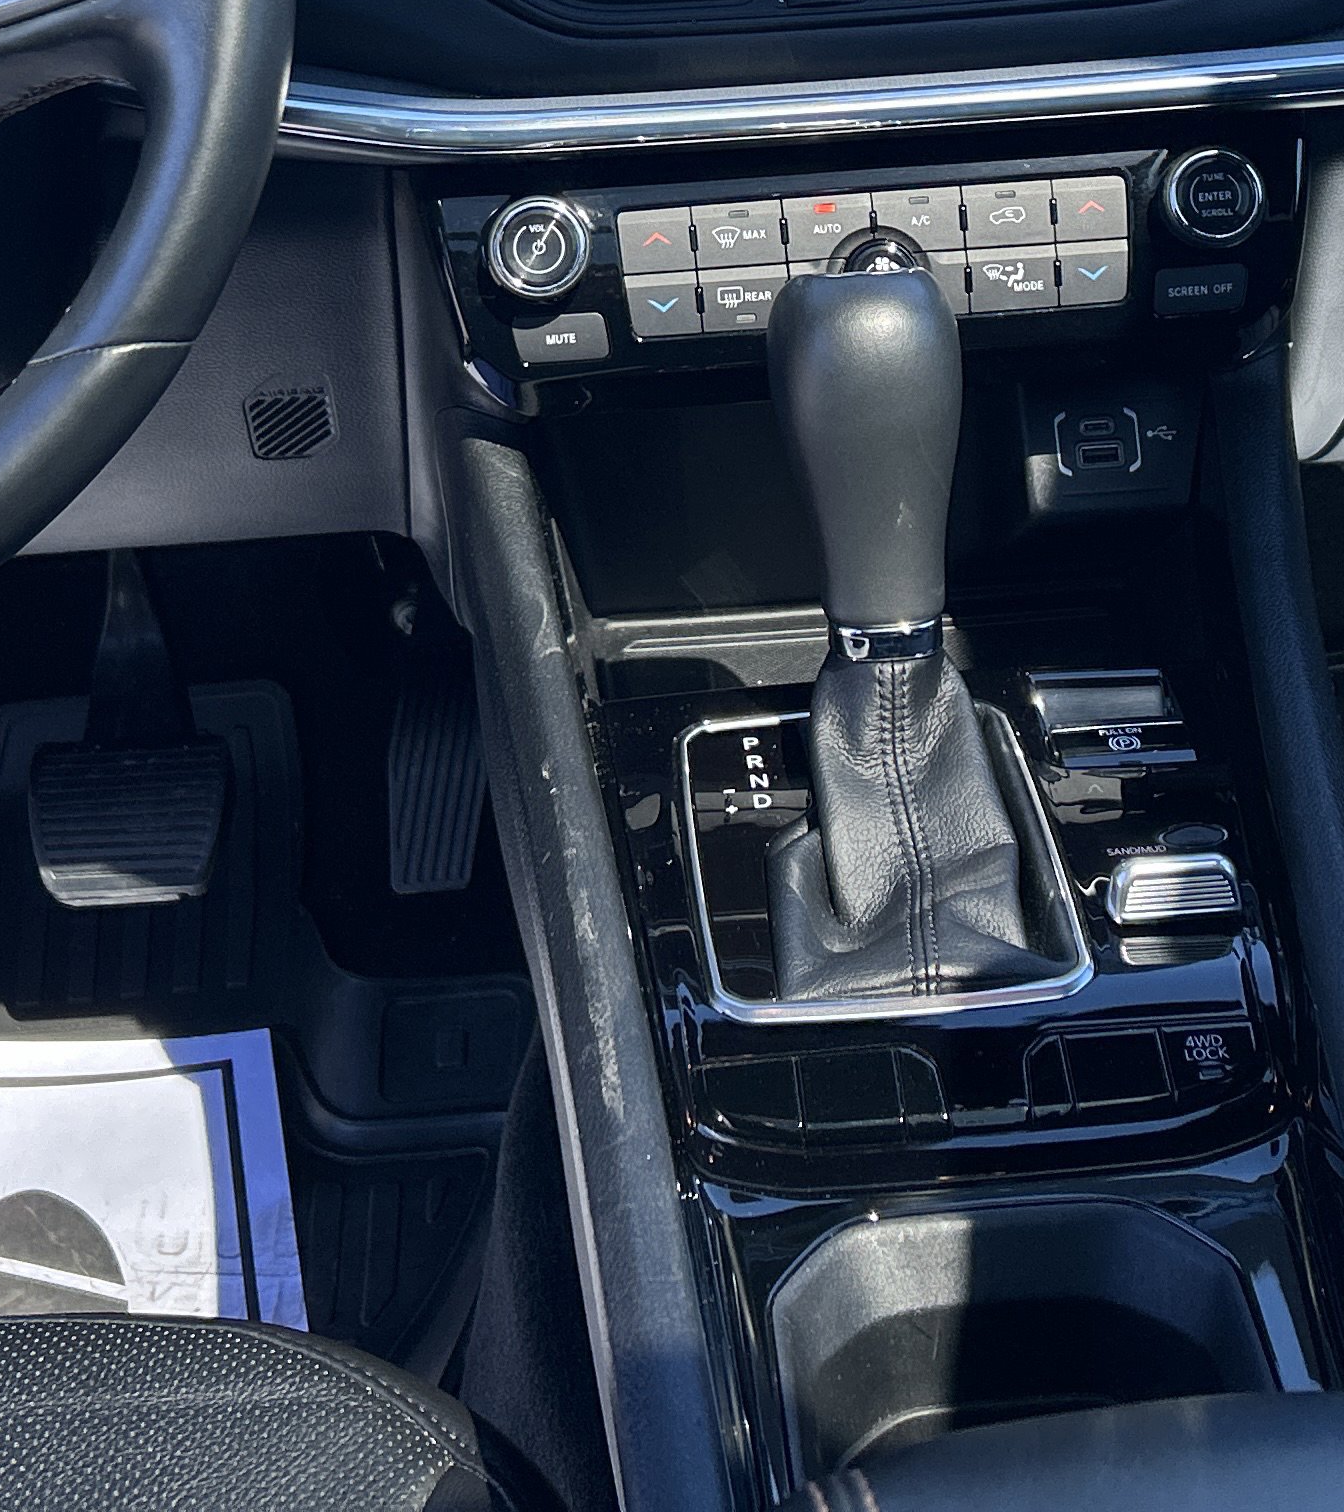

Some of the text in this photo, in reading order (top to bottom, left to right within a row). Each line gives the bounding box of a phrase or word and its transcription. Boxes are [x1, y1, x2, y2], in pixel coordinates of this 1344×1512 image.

[1202, 172, 1226, 182] TUNE
[1198, 190, 1233, 203] ENTER
[1200, 206, 1234, 218] SCROLL
[911, 214, 931, 227] A/C
[528, 224, 546, 234] VOL
[743, 228, 767, 241] MAX
[813, 223, 842, 235] AUTO
[1013, 279, 1045, 292] MODE
[1168, 282, 1234, 297] SCREEN OFF
[744, 290, 773, 303] REAR
[545, 332, 577, 345] MUTE
[742, 736, 759, 751] P
[746, 754, 764, 769] R
[749, 773, 769, 789] N
[752, 793, 772, 809] D
[1106, 844, 1167, 857] SAND/MUD
[1185, 1034, 1223, 1048] 4WD
[1183, 1046, 1230, 1061] LOCK
